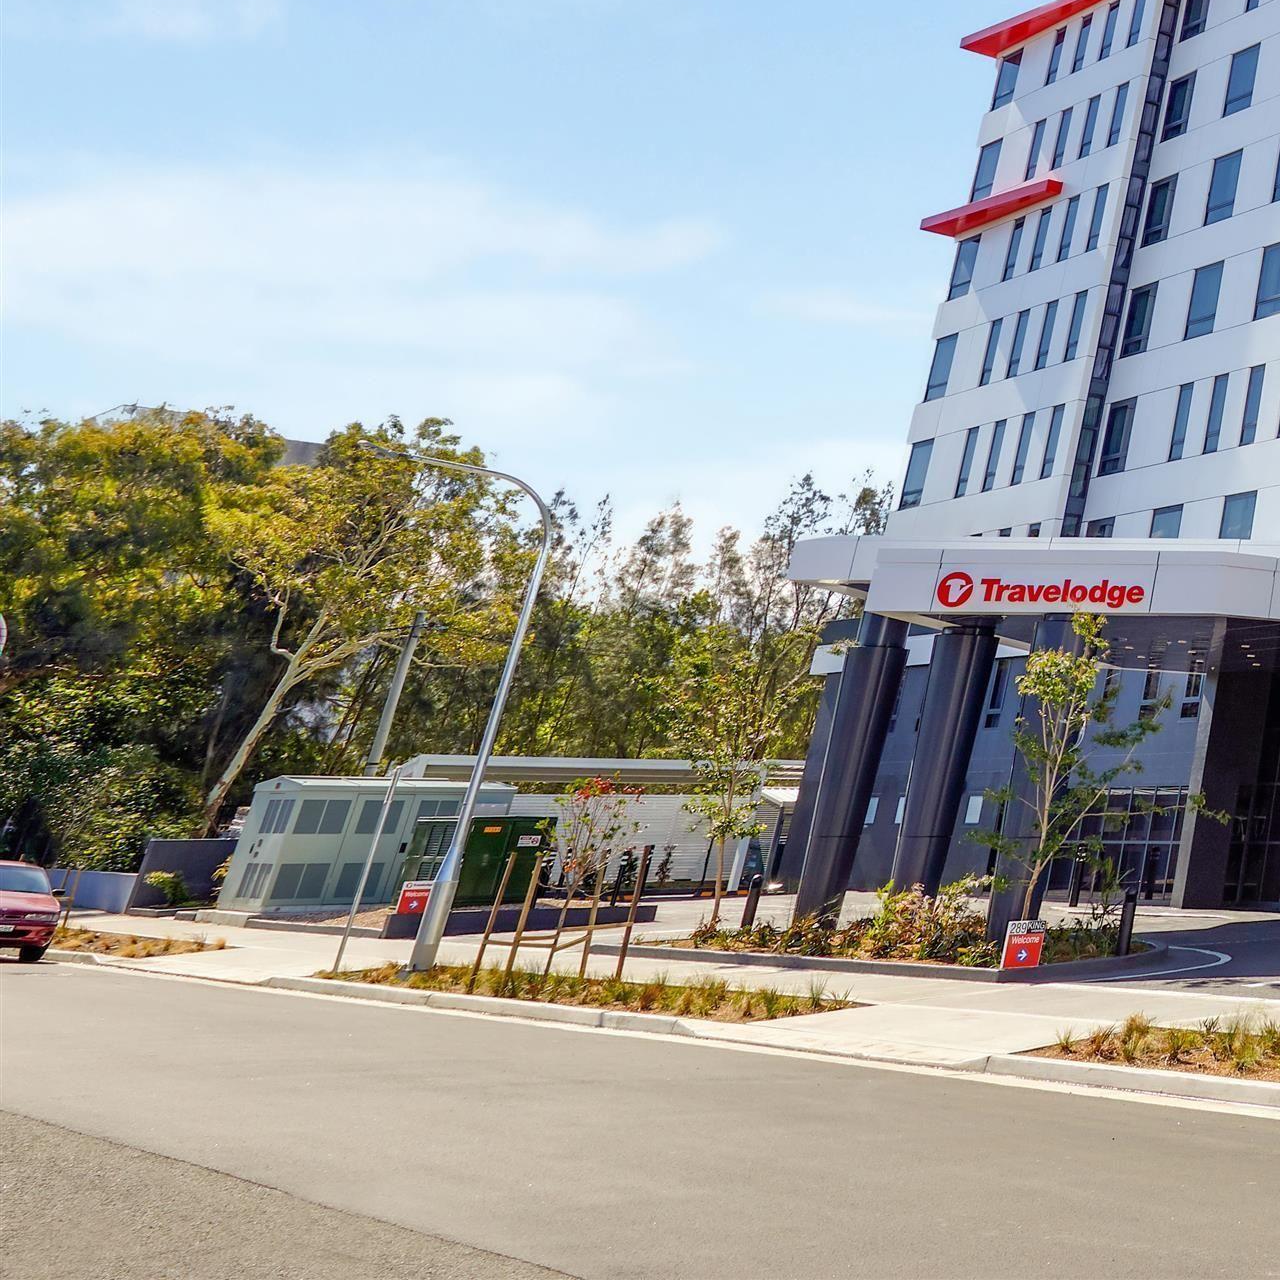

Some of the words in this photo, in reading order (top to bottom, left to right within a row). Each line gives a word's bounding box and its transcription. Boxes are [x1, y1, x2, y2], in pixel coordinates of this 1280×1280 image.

[979, 577, 1145, 609] Travelodge
[1010, 922, 1027, 934] 289
[1027, 920, 1046, 930] KING
[1011, 935, 1040, 945] Welcome
